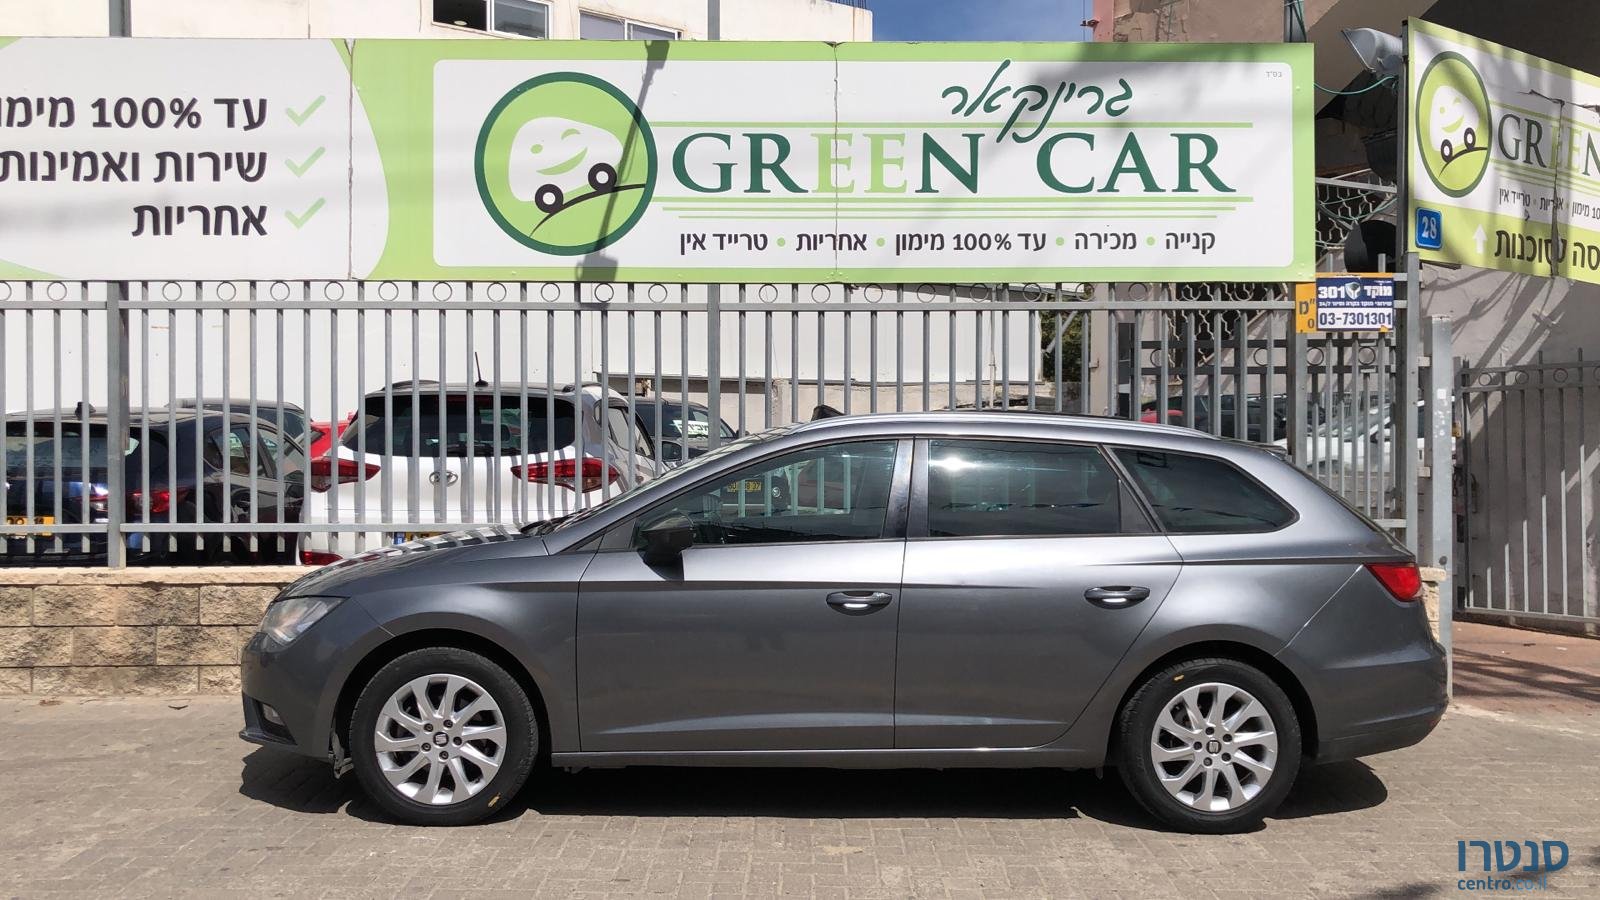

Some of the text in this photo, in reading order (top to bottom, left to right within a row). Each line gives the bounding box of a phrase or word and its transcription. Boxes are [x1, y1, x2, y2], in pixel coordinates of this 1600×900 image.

[91, 98, 201, 129] 100%
[213, 98, 267, 131] עד
[941, 59, 1133, 143] גרינקאר
[0, 150, 267, 183] שירות ואמינות
[672, 131, 1237, 194] GREEN CAR
[1499, 188, 1510, 205] אין
[131, 204, 267, 237] אחריות
[1421, 215, 1437, 239] 28
[680, 232, 1216, 257] קנייה מכירה עד 100% מימון אחריות טרייד אין
[1318, 283, 1393, 299] מוקד 301
[1319, 311, 1392, 326] 03-7301301
